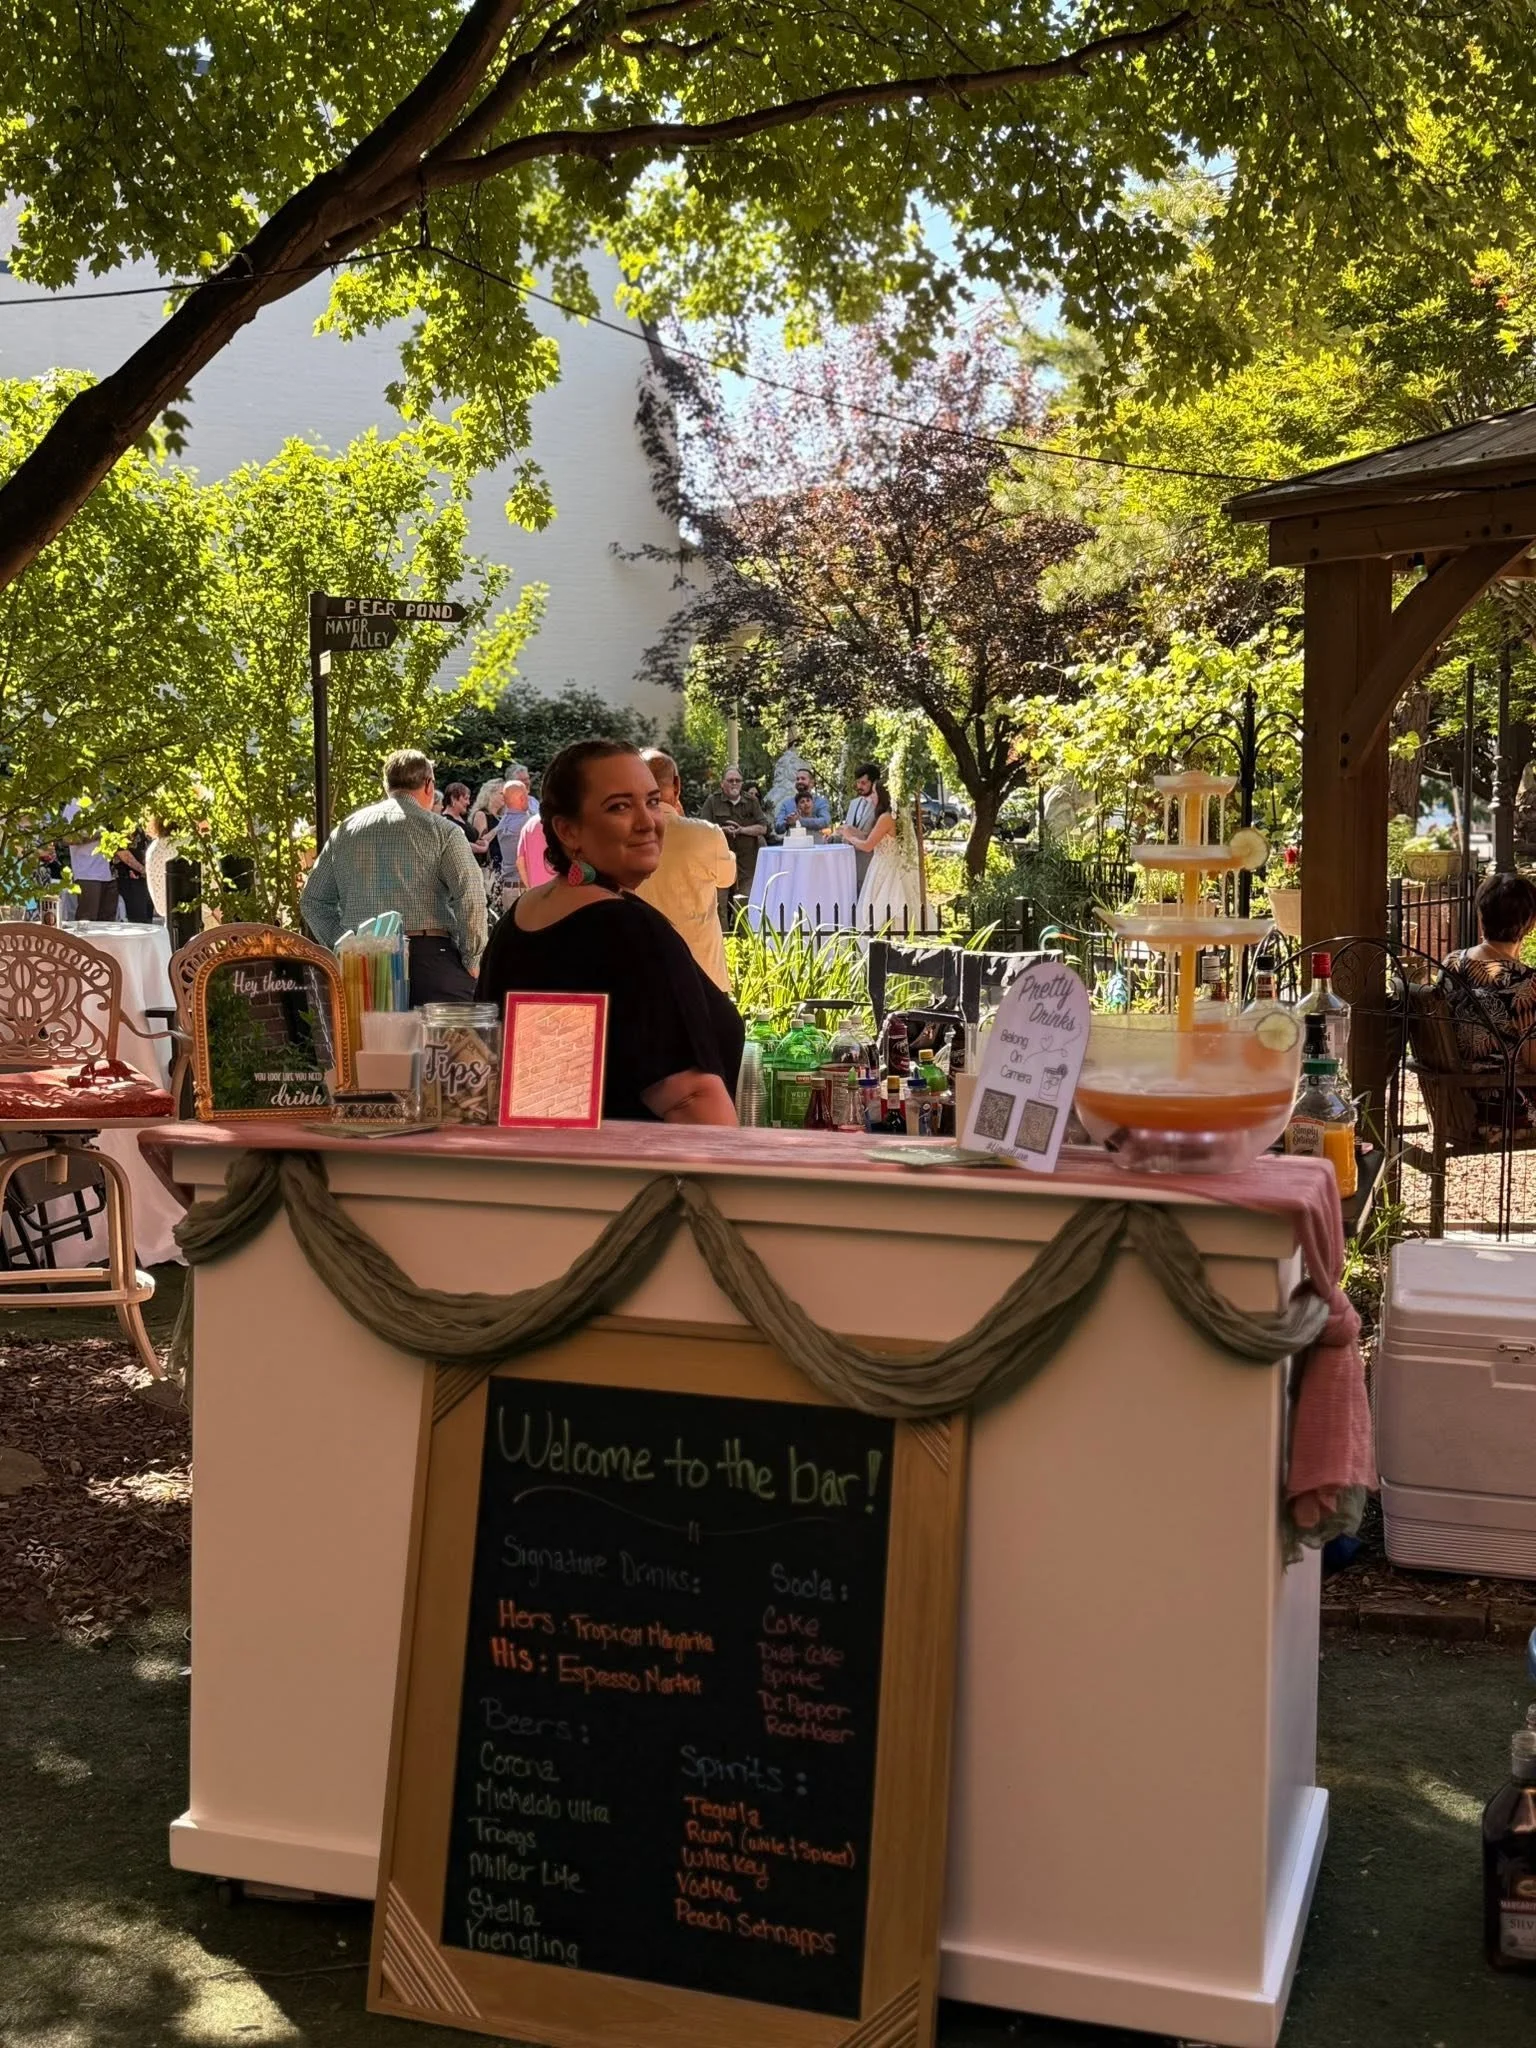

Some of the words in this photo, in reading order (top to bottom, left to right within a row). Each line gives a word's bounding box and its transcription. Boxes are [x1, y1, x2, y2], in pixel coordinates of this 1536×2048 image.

[405, 603, 453, 619] POND
[325, 618, 369, 636] MAYOR
[350, 631, 390, 649] ALLEY
[232, 970, 258, 998] Hey
[1019, 973, 1075, 1011] Pretty
[1029, 1002, 1076, 1032] Drinks
[1000, 1028, 1030, 1049] Belong
[424, 1043, 491, 1096] Tips
[1009, 1050, 1023, 1063] On
[295, 1072, 307, 1081] YOU
[1000, 1065, 1033, 1085] Camera
[271, 1083, 327, 1106] drink
[1292, 1124, 1319, 1140] Simply
[1293, 1135, 1319, 1149] Orange
[499, 1405, 656, 1482] Welcome
[664, 1437, 709, 1489] to
[716, 1437, 776, 1500] the
[502, 1534, 608, 1588] Signature
[568, 1613, 643, 1650] Tropical
[762, 1604, 820, 1638] Coke
[757, 1641, 800, 1664] Diet
[804, 1643, 845, 1667] Coke
[762, 1662, 825, 1691] Sprite
[786, 1692, 851, 1722] Pepper
[480, 1739, 560, 1783] Corona
[566, 1799, 612, 1825] Ultra
[682, 1794, 766, 1829] Tequila
[685, 1819, 734, 1848] Rum
[469, 1852, 535, 1883] Miller
[540, 1860, 588, 1895] Lite
[675, 1871, 743, 1904] Vodka
[467, 1886, 541, 1927] Stella
[675, 1897, 732, 1934] Peach
[465, 1919, 581, 1968] Yuengling
